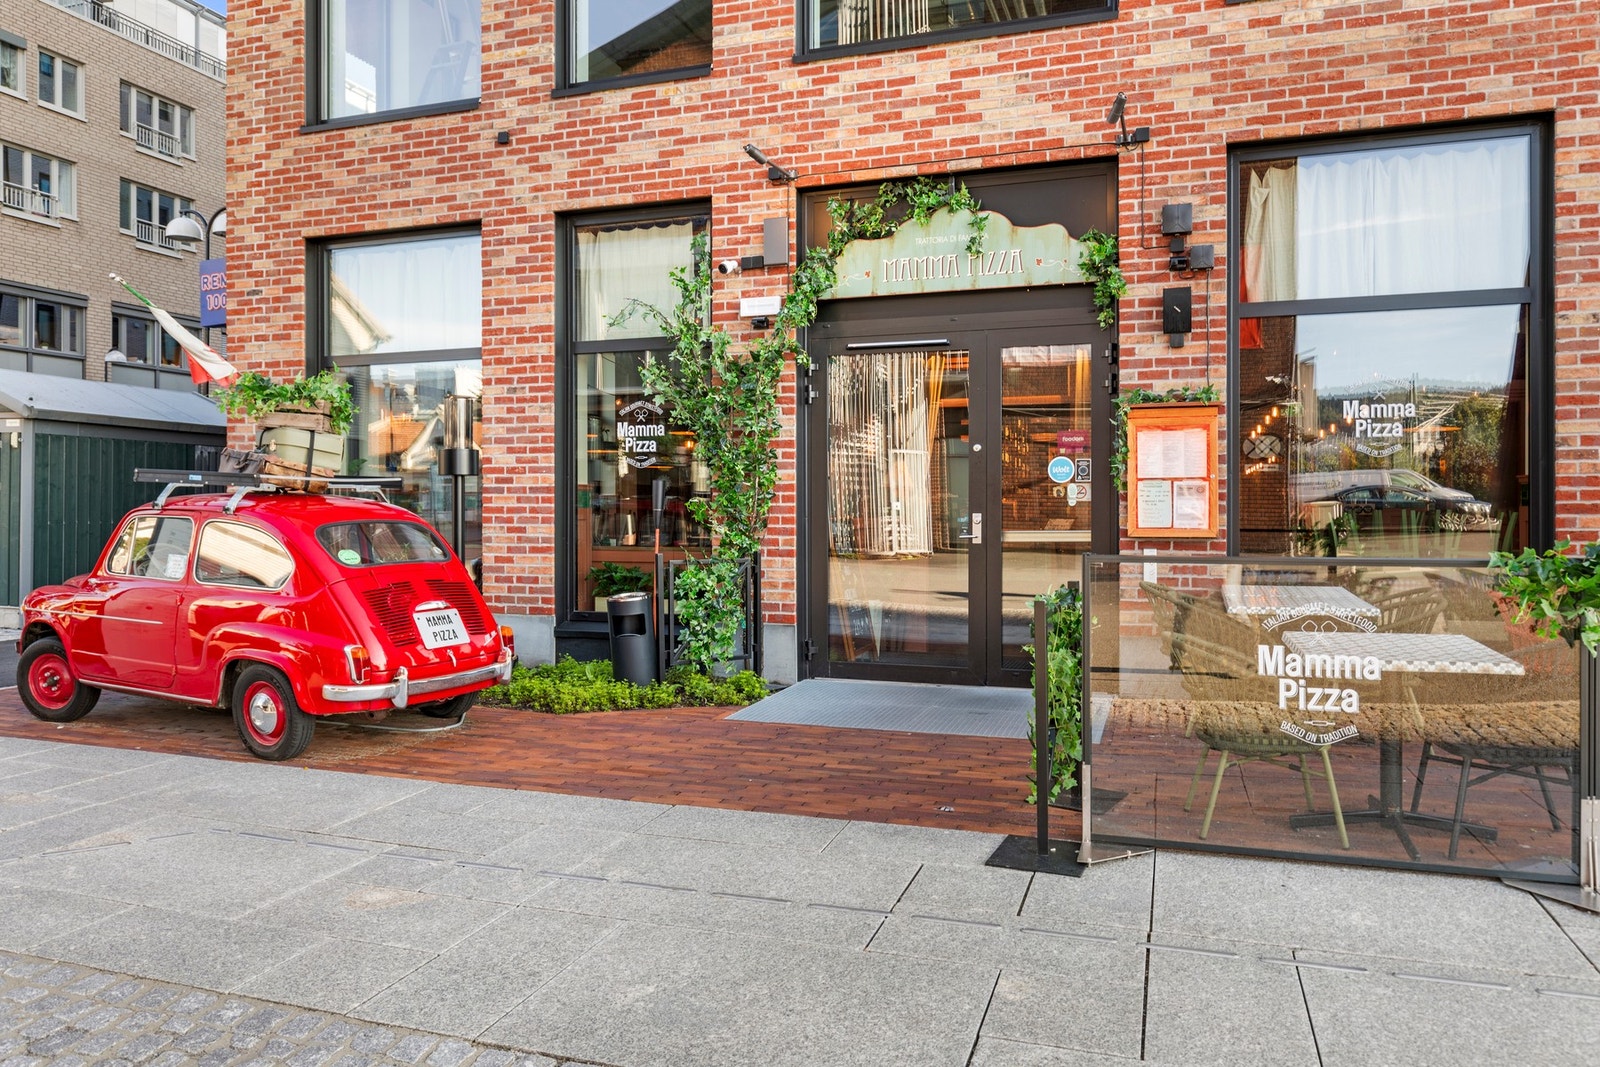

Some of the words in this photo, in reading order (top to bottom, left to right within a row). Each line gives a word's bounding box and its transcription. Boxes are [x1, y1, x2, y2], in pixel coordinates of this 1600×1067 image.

[915, 235, 949, 246] TRATTORIA
[950, 234, 957, 243] DI
[883, 253, 960, 284] MAMMA
[967, 249, 1025, 277] PIZZA
[1342, 400, 1416, 418] Mamma
[617, 421, 665, 437] Mamma
[1355, 419, 1403, 438] Pizza
[625, 437, 657, 453] Pizza
[1261, 611, 1290, 630] ITALIAN
[433, 629, 459, 642] PIZZA
[1257, 644, 1382, 680] Mamma
[1278, 678, 1360, 713] Pizza
[1280, 721, 1306, 738] BASED
[1305, 732, 1317, 743] ON
[1319, 724, 1358, 743] TRADITION
